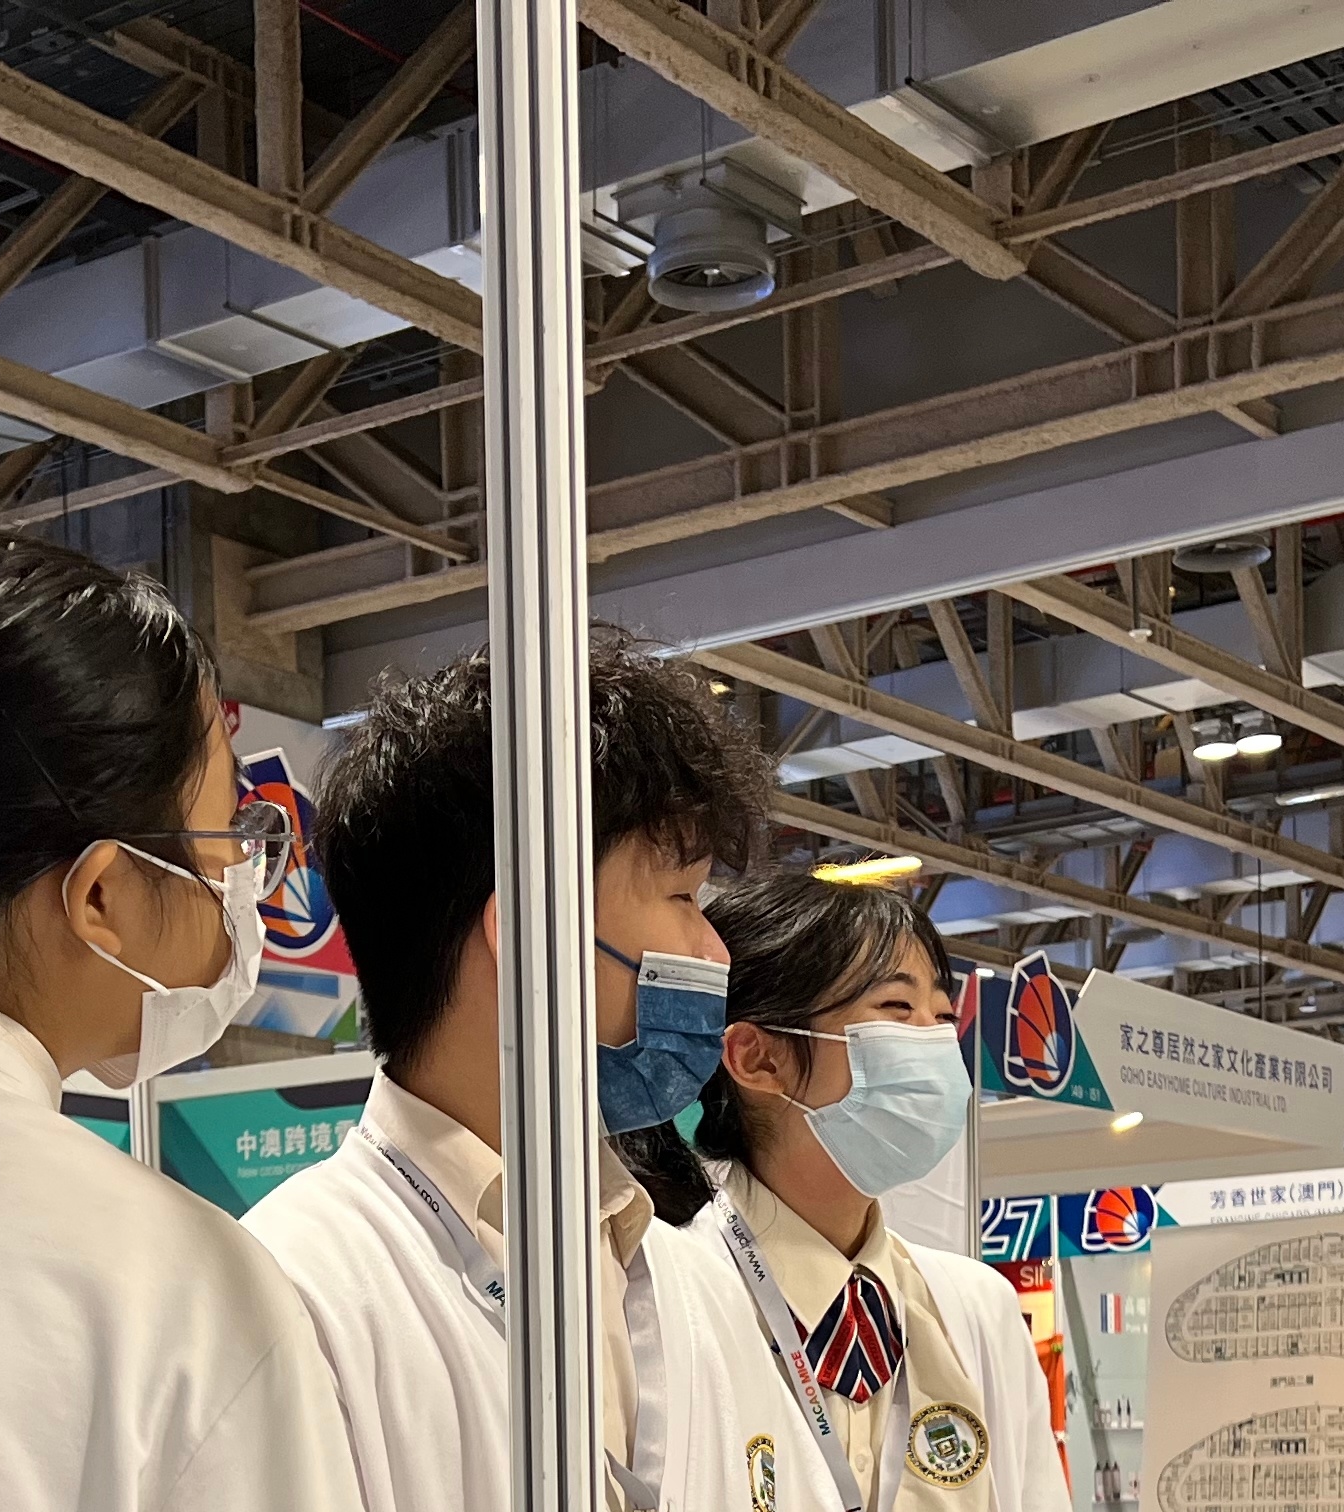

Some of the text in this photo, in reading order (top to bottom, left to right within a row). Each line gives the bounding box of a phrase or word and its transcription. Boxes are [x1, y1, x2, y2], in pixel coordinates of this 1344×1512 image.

[1192, 1079, 1227, 1101] CULTURE
[790, 1351, 832, 1436] MACAO MICE
